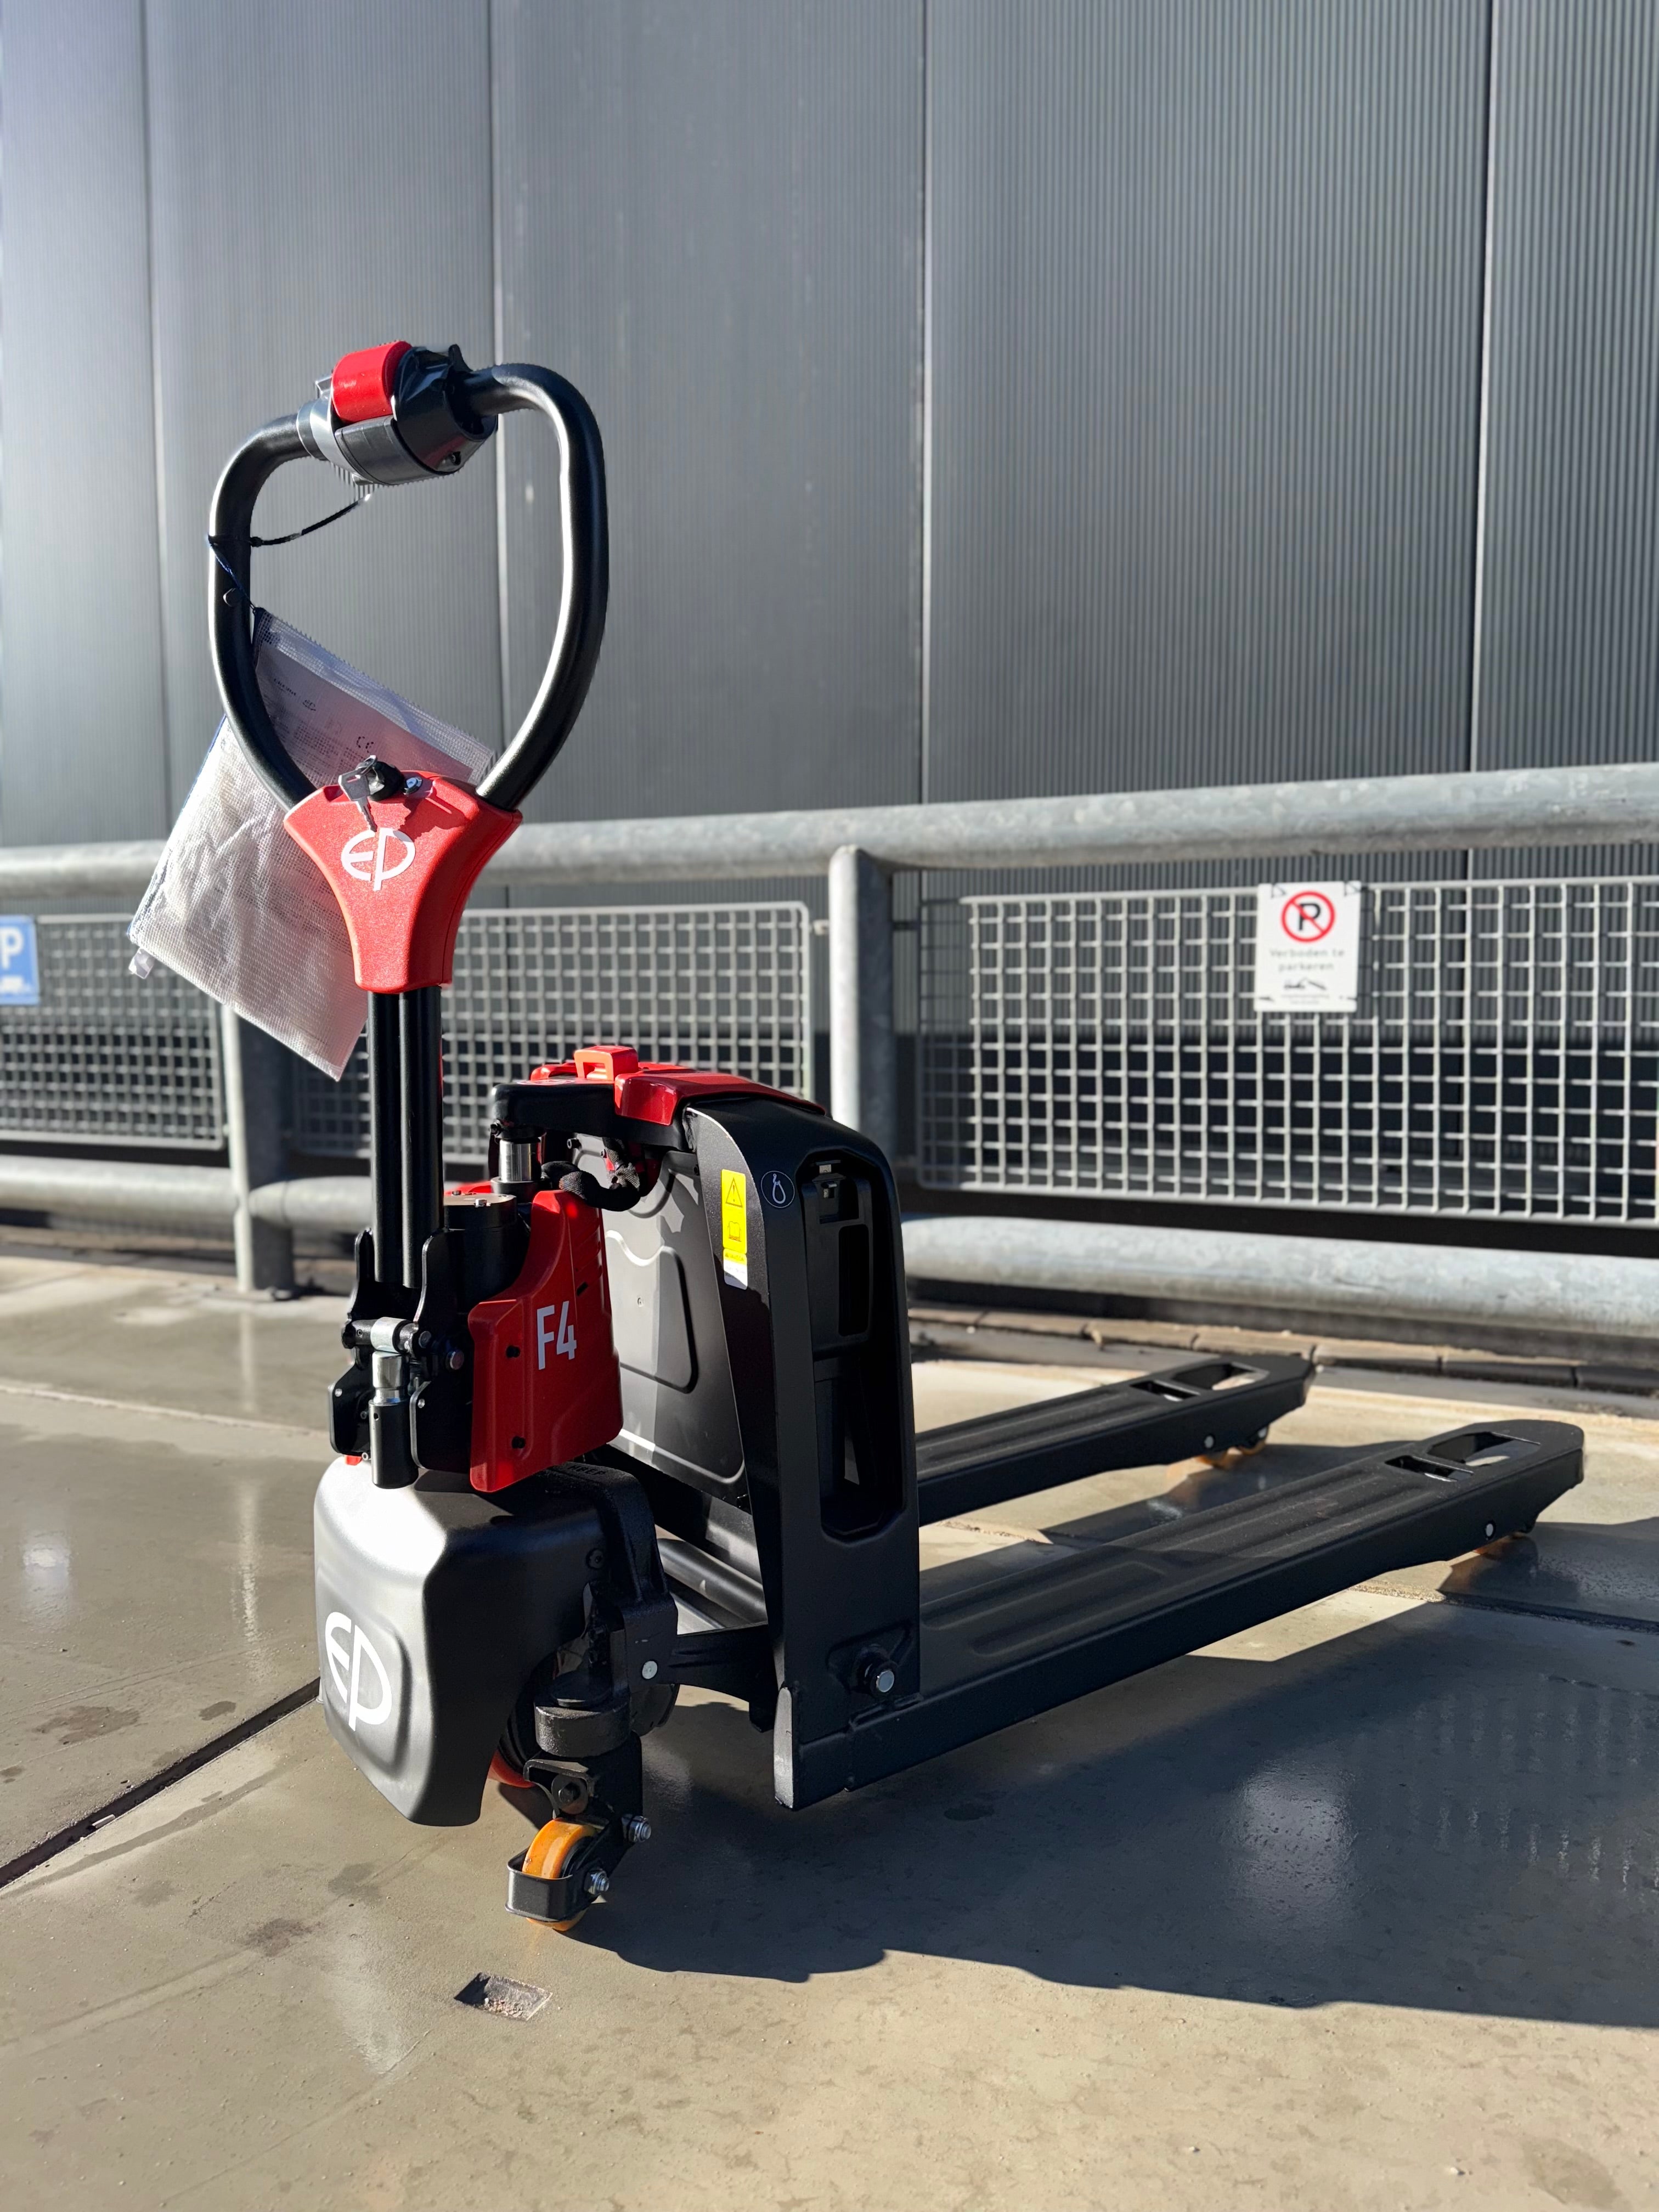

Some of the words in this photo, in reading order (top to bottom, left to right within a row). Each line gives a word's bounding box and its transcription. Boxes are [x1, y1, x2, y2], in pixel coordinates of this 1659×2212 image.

[341, 827, 416, 892] EP
[0, 926, 24, 970] P
[537, 1300, 577, 1370] F4
[325, 1611, 393, 1732] EP
